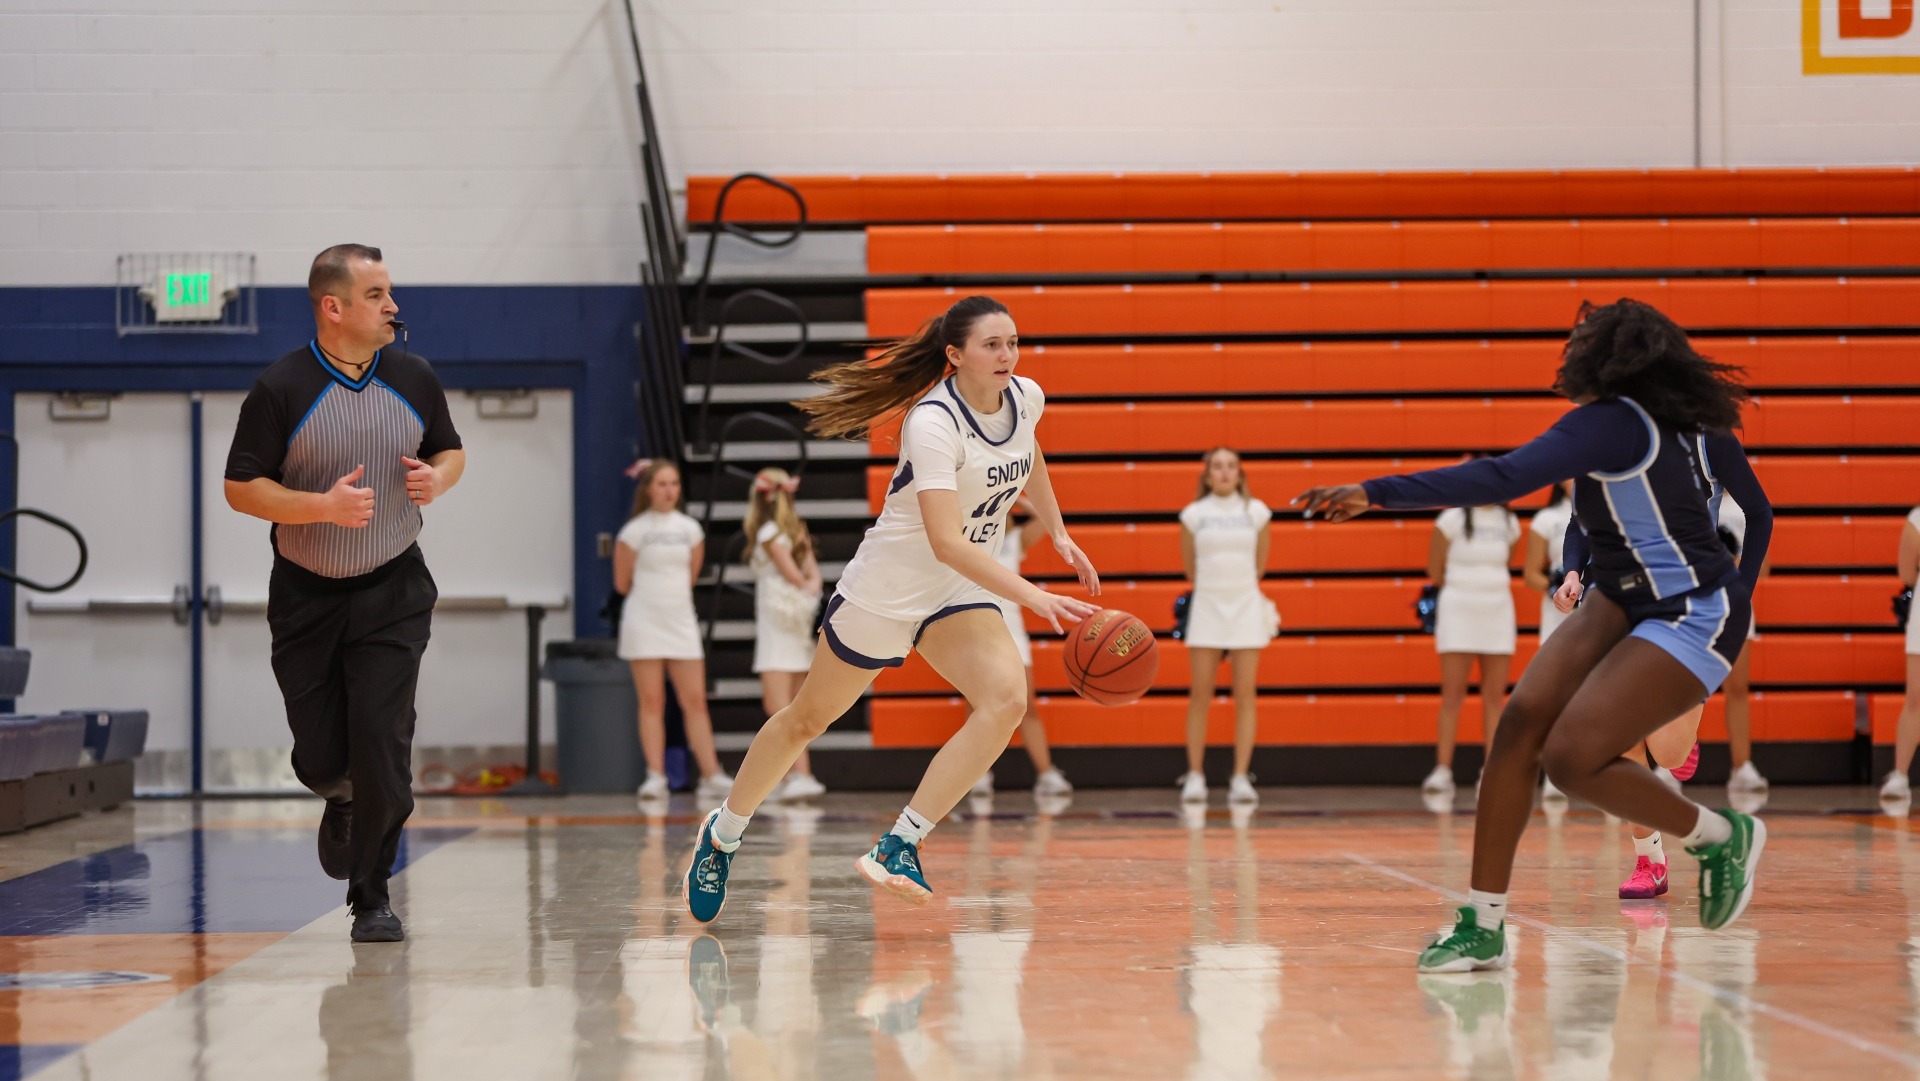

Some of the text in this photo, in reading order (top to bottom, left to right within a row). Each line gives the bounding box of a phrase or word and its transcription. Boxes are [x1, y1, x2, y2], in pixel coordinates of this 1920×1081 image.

[166, 273, 212, 306] EXIT
[987, 452, 1031, 488] SNOW
[971, 486, 1018, 518] 10
